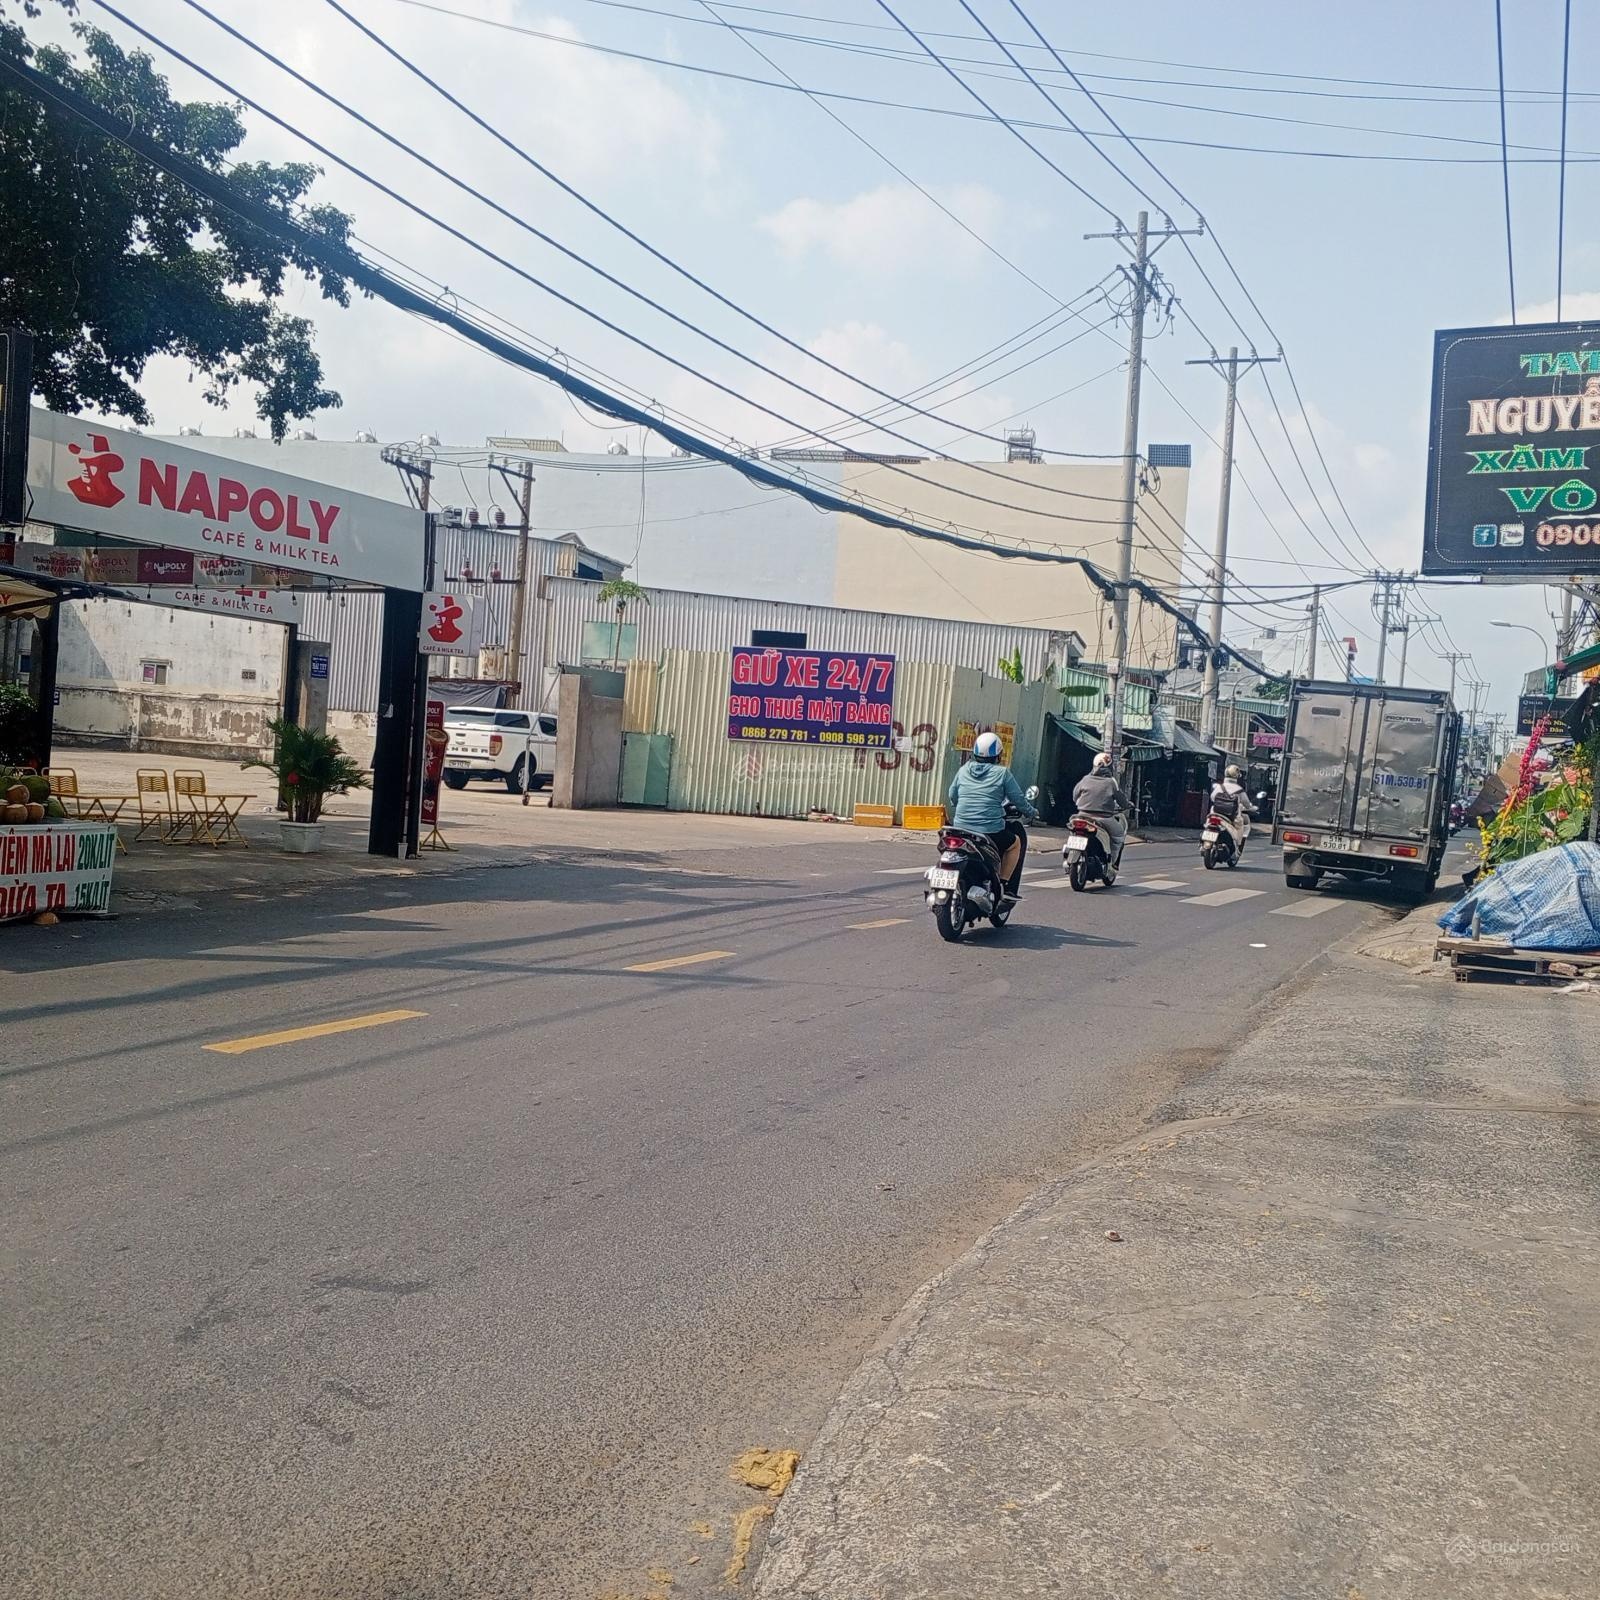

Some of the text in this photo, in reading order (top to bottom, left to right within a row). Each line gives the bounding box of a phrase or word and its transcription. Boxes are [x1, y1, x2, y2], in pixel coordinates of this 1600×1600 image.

[1465, 376, 1600, 436] NGUYỄ
[1465, 444, 1592, 474] XĂM
[138, 457, 341, 544] NAPOLY
[1498, 479, 1598, 512] VÔ
[202, 528, 339, 567] CAFÉ & MILK TEA
[175, 591, 206, 604] CAFÉ
[212, 597, 219, 605] &
[222, 599, 250, 610] MILK
[253, 603, 273, 614] TEA
[733, 650, 893, 694] GIỮ XE 24/7
[729, 695, 891, 726] CHO THUÊ MẶT BẰNG
[741, 726, 766, 739] 0868
[769, 728, 788, 740] 279
[791, 729, 808, 741] 781
[819, 732, 844, 744] 0908
[846, 733, 865, 745] 596
[867, 734, 887, 746] 217
[31, 827, 53, 873] MÃ
[56, 834, 76, 872] LAI
[77, 826, 115, 870] 20K/LÍT
[46, 883, 65, 912] TA
